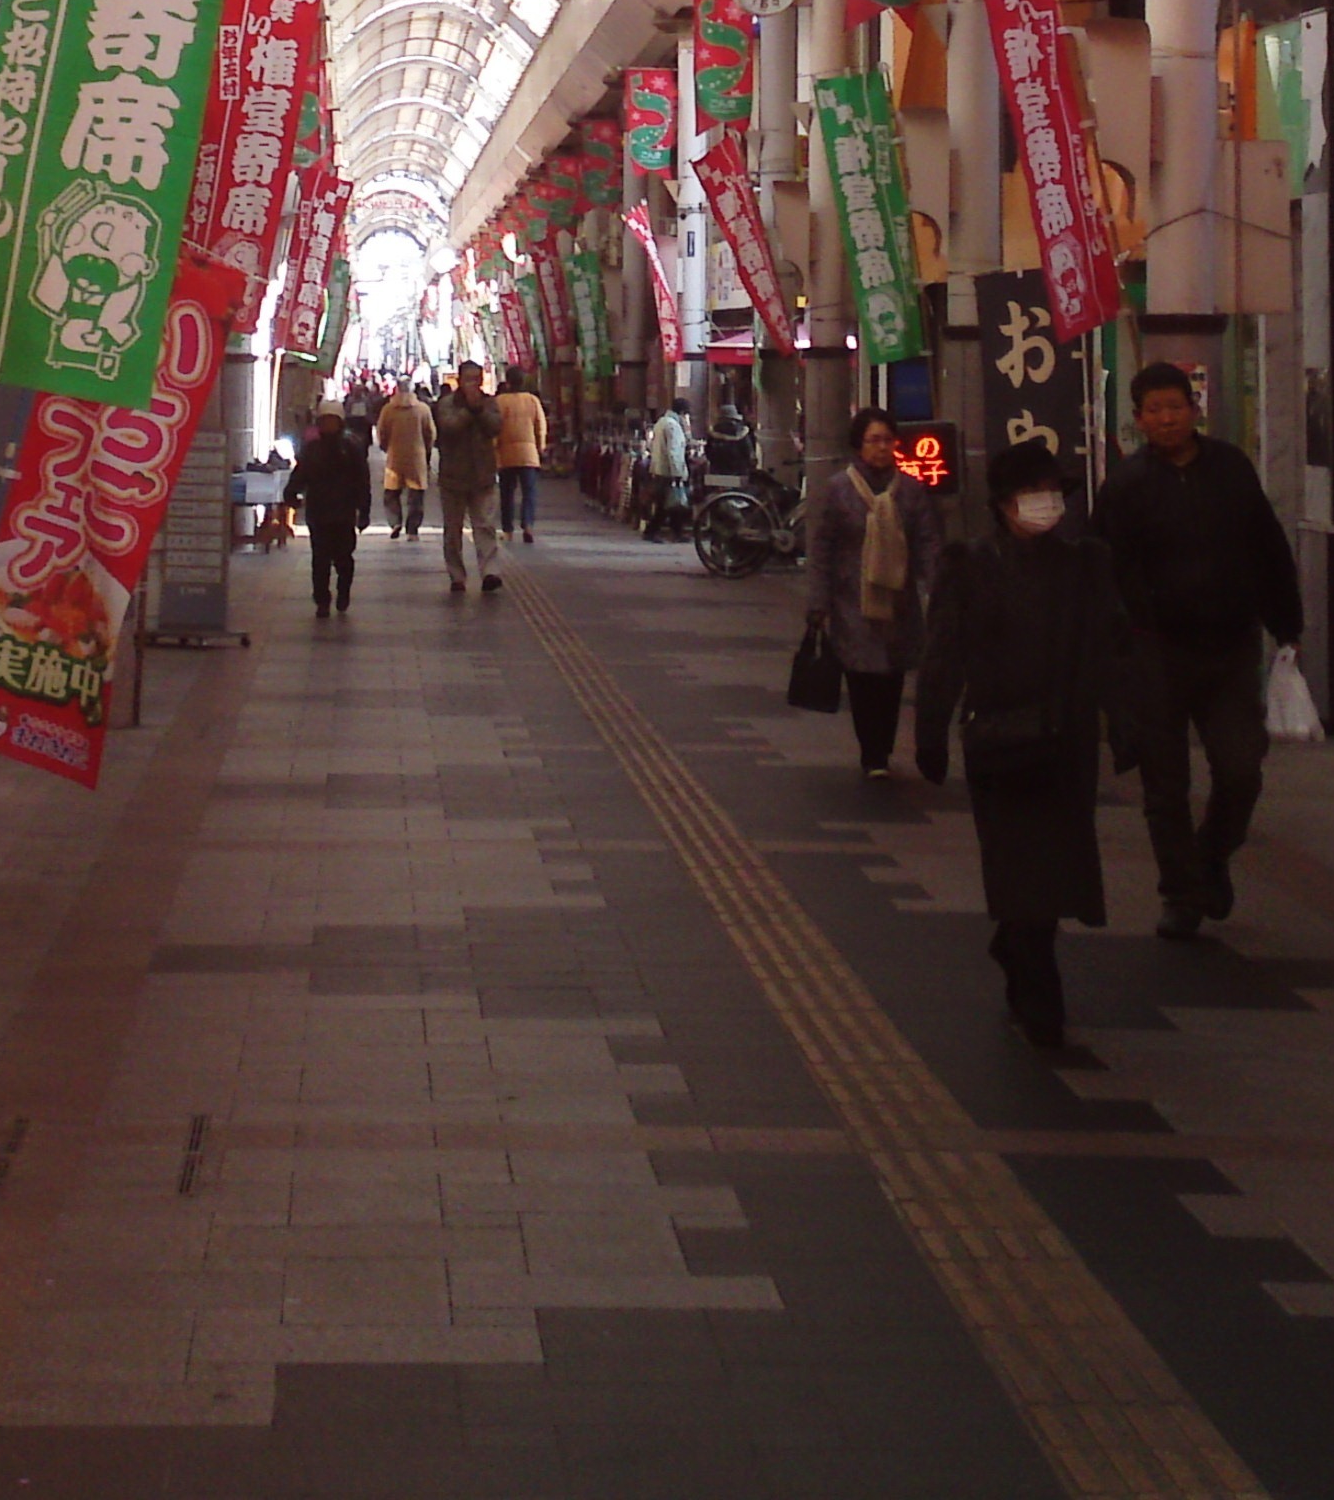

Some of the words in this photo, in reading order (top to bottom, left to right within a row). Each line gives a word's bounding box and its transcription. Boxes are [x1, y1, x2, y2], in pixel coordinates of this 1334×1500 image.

[220, 35, 298, 236] 権堂寄席
[9, 395, 99, 591] フェア
